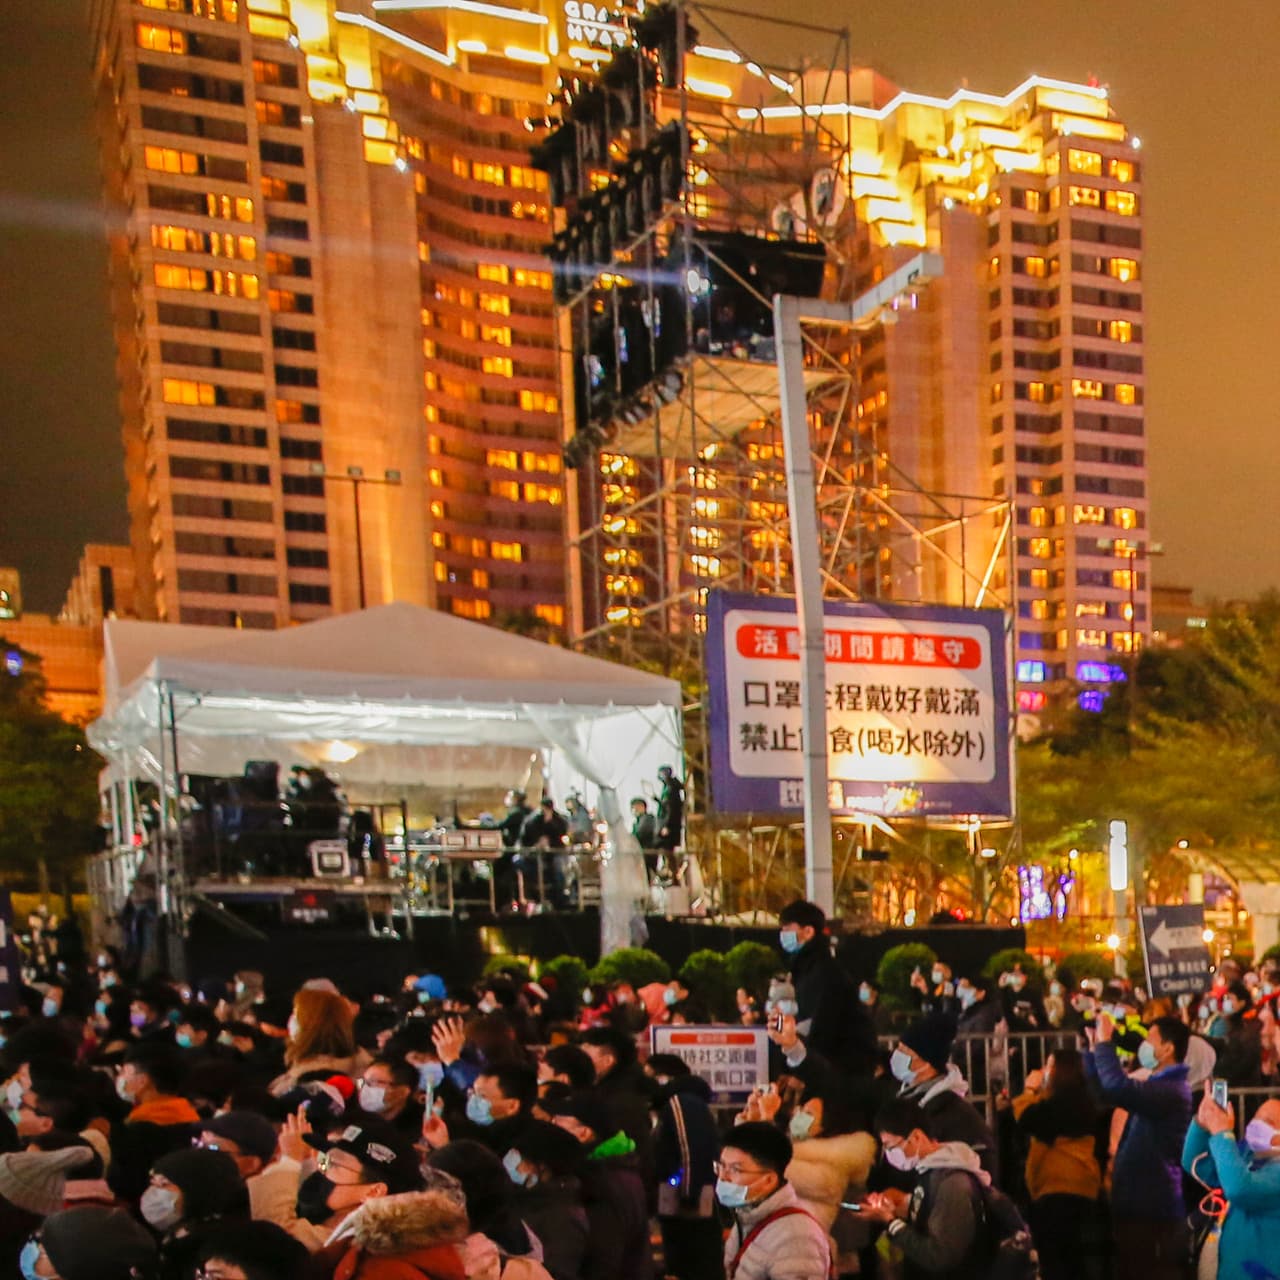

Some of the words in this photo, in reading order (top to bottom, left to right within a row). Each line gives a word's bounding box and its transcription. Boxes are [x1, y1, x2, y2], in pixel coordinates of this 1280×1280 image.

[743, 680, 980, 716] 口罩程戴好戴滿
[739, 722, 985, 761] 禁止食(喝水除外)
